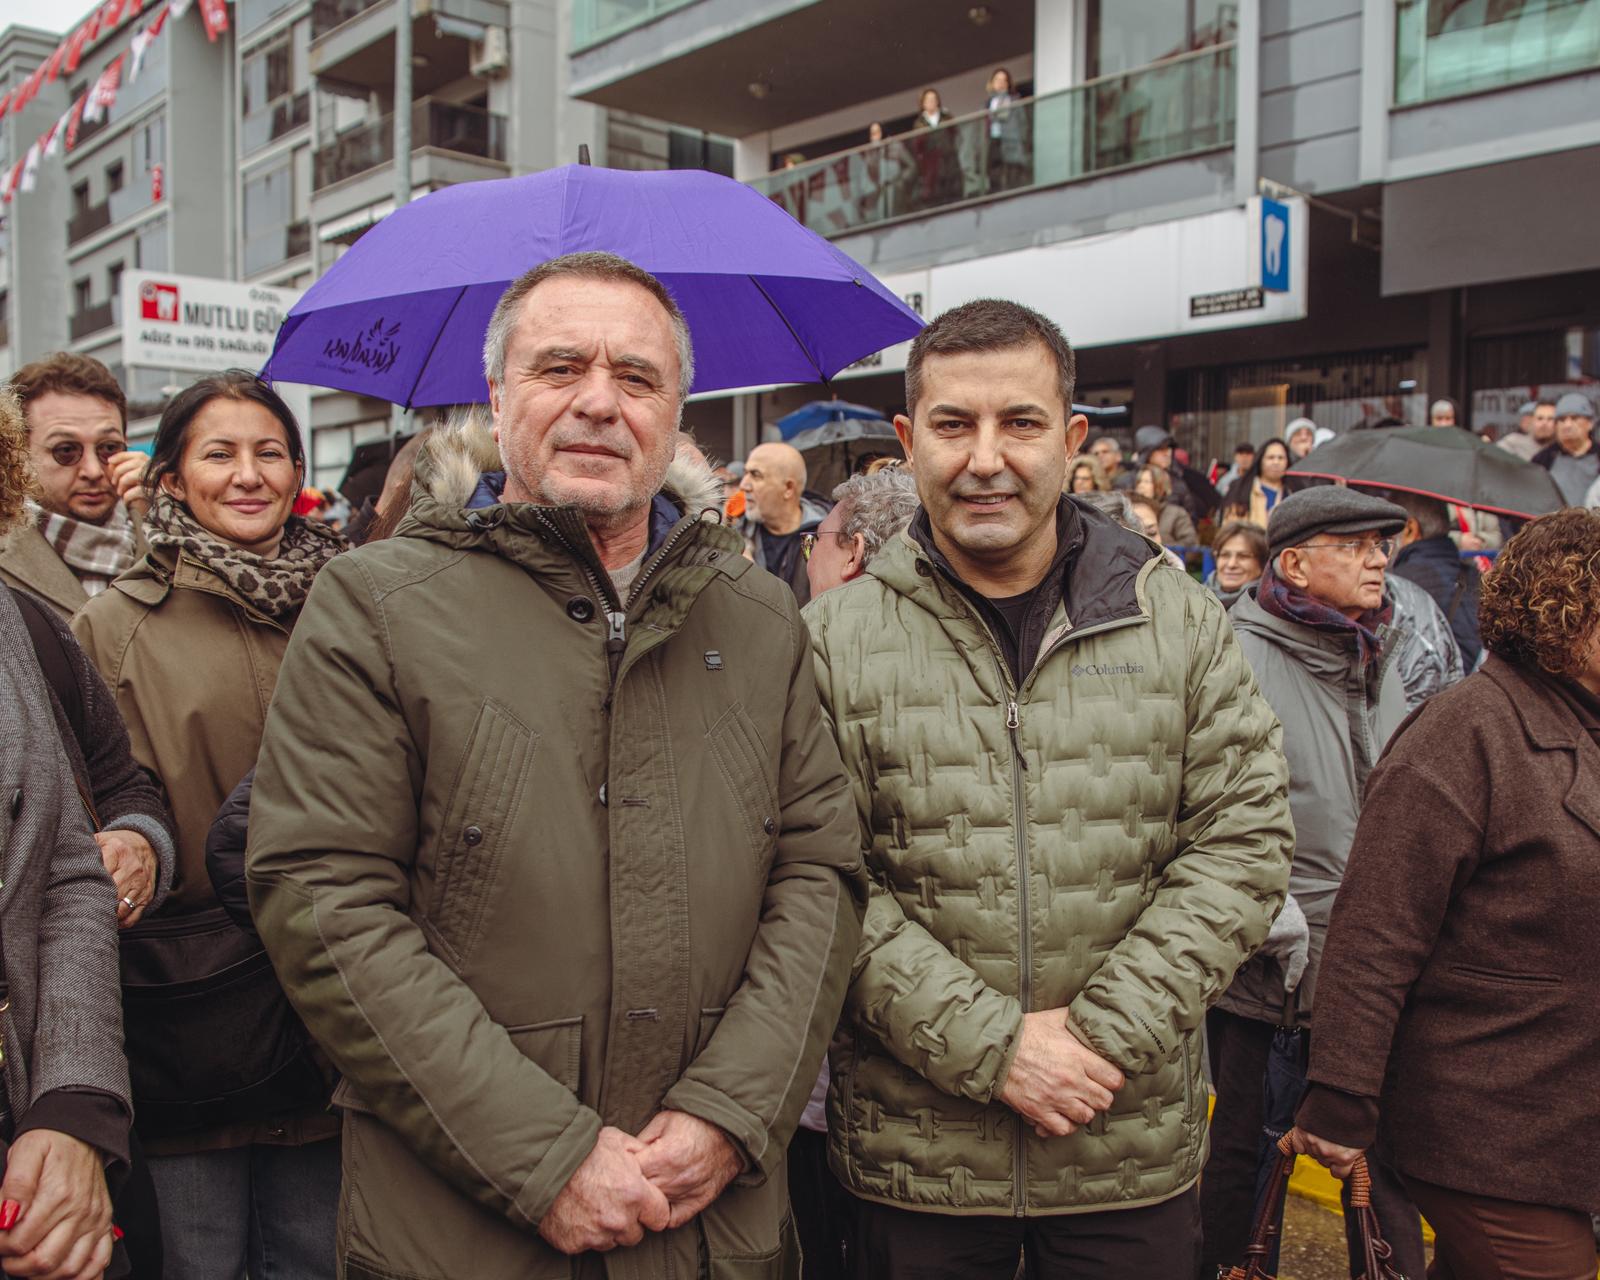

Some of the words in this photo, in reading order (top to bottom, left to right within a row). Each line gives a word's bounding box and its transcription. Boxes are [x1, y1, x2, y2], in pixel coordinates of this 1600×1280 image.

[184, 302, 249, 331] MUTLU
[253, 306, 282, 335] GÜ
[1085, 662, 1144, 676] Columbia
[1131, 1010, 1166, 1055] OMNI-HEAT
